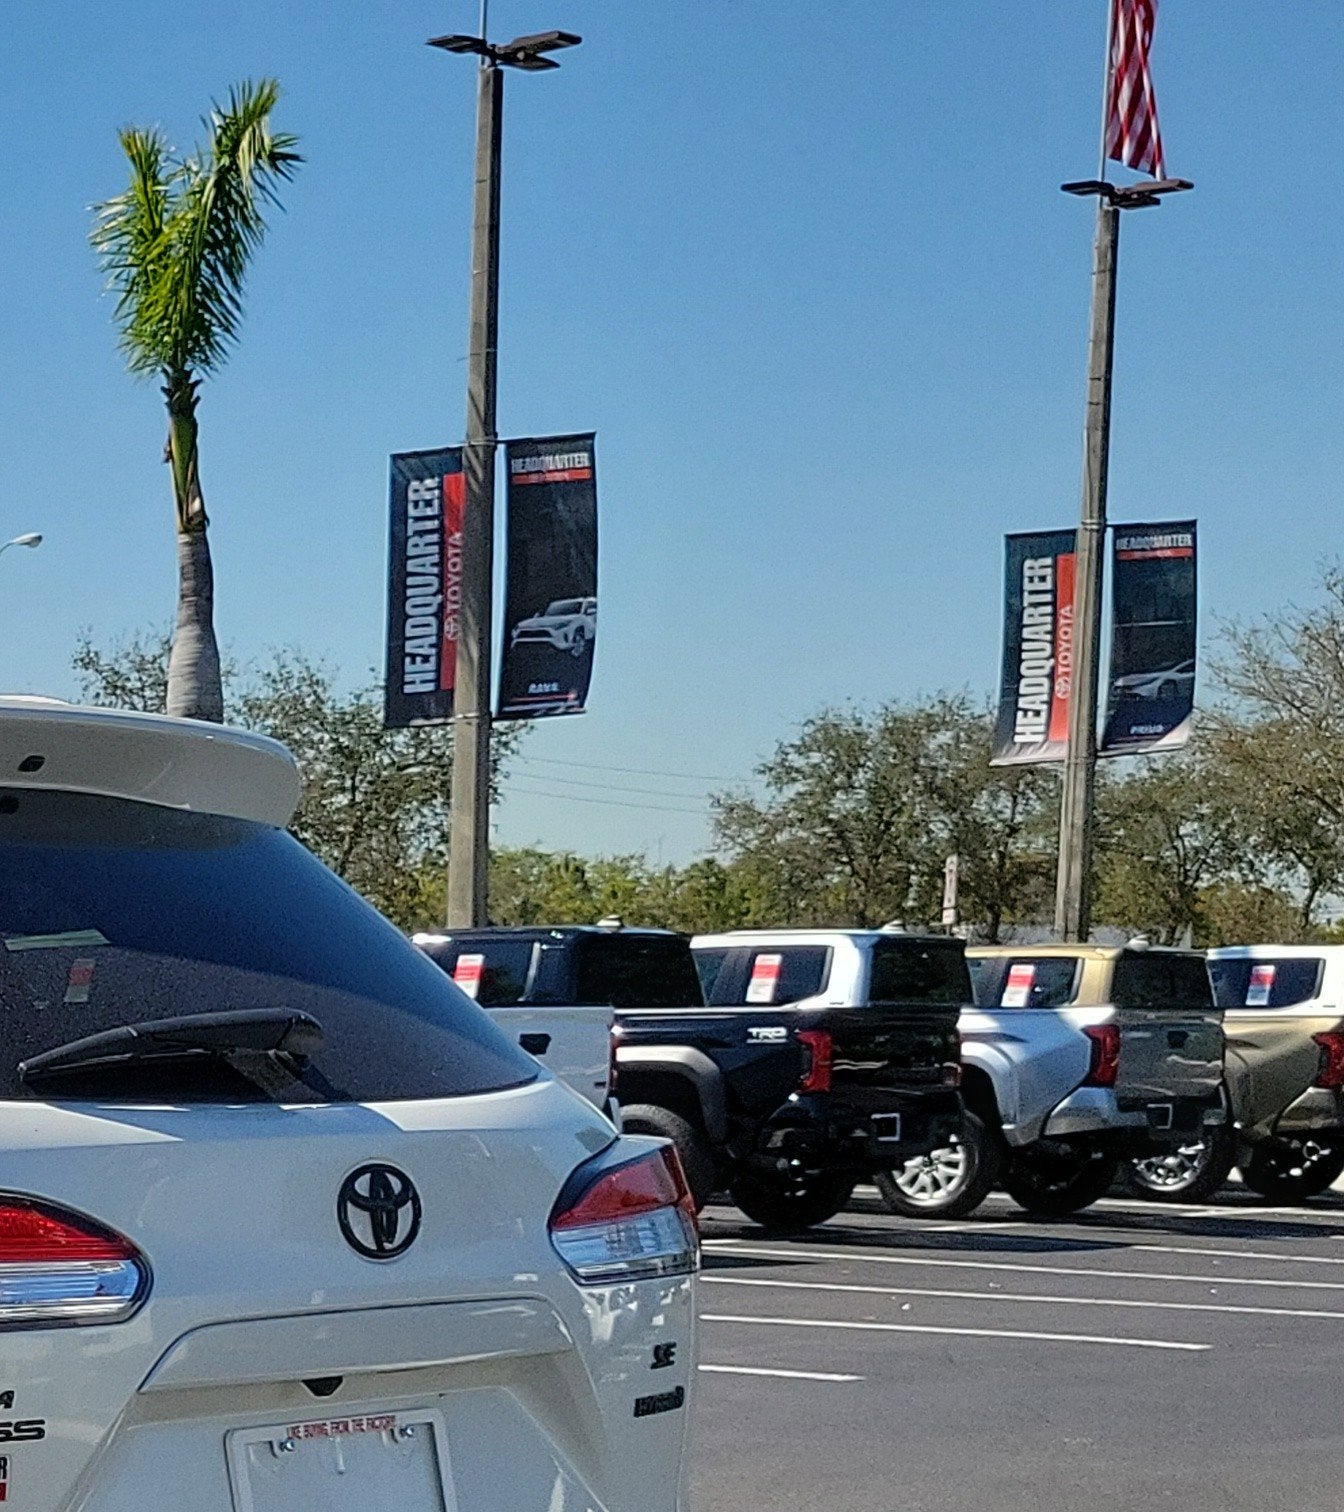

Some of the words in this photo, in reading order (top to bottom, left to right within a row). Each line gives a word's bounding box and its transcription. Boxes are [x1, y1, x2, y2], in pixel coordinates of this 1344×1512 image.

[403, 476, 444, 694] HEADQUARTER
[446, 532, 463, 613] TOYOTA
[1057, 604, 1073, 671] TOYOTA
[1014, 556, 1054, 743] HEADQUARTER
